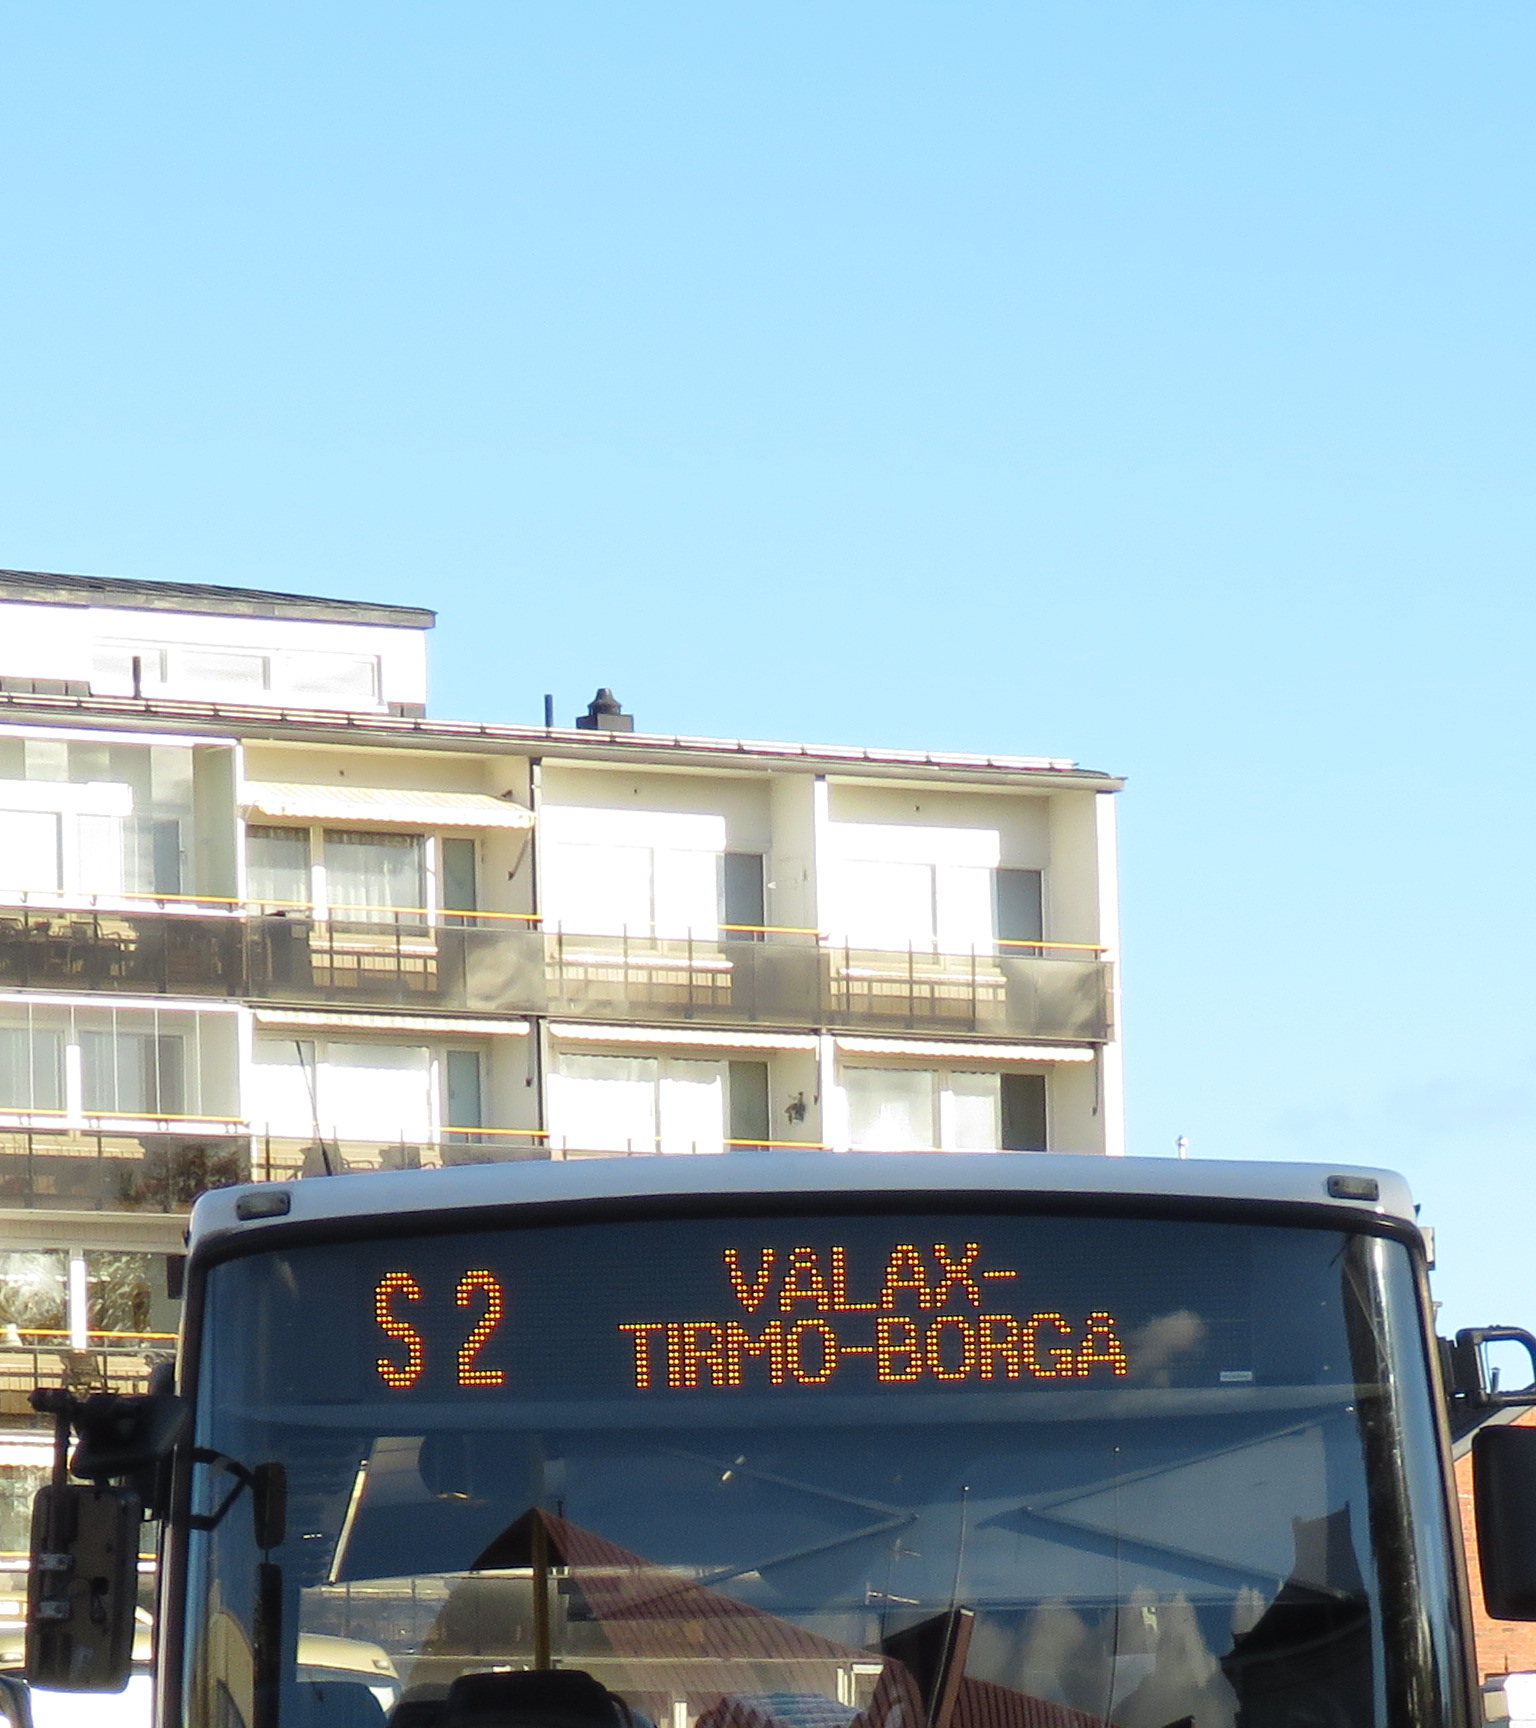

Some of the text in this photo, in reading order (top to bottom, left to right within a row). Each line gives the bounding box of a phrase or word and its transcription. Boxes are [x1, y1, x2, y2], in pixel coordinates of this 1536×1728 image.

[722, 1241, 1019, 1313] VÅLAX-
[374, 1269, 505, 1387] S 2
[617, 1311, 1128, 1388] TIRMO-BORGÅ
